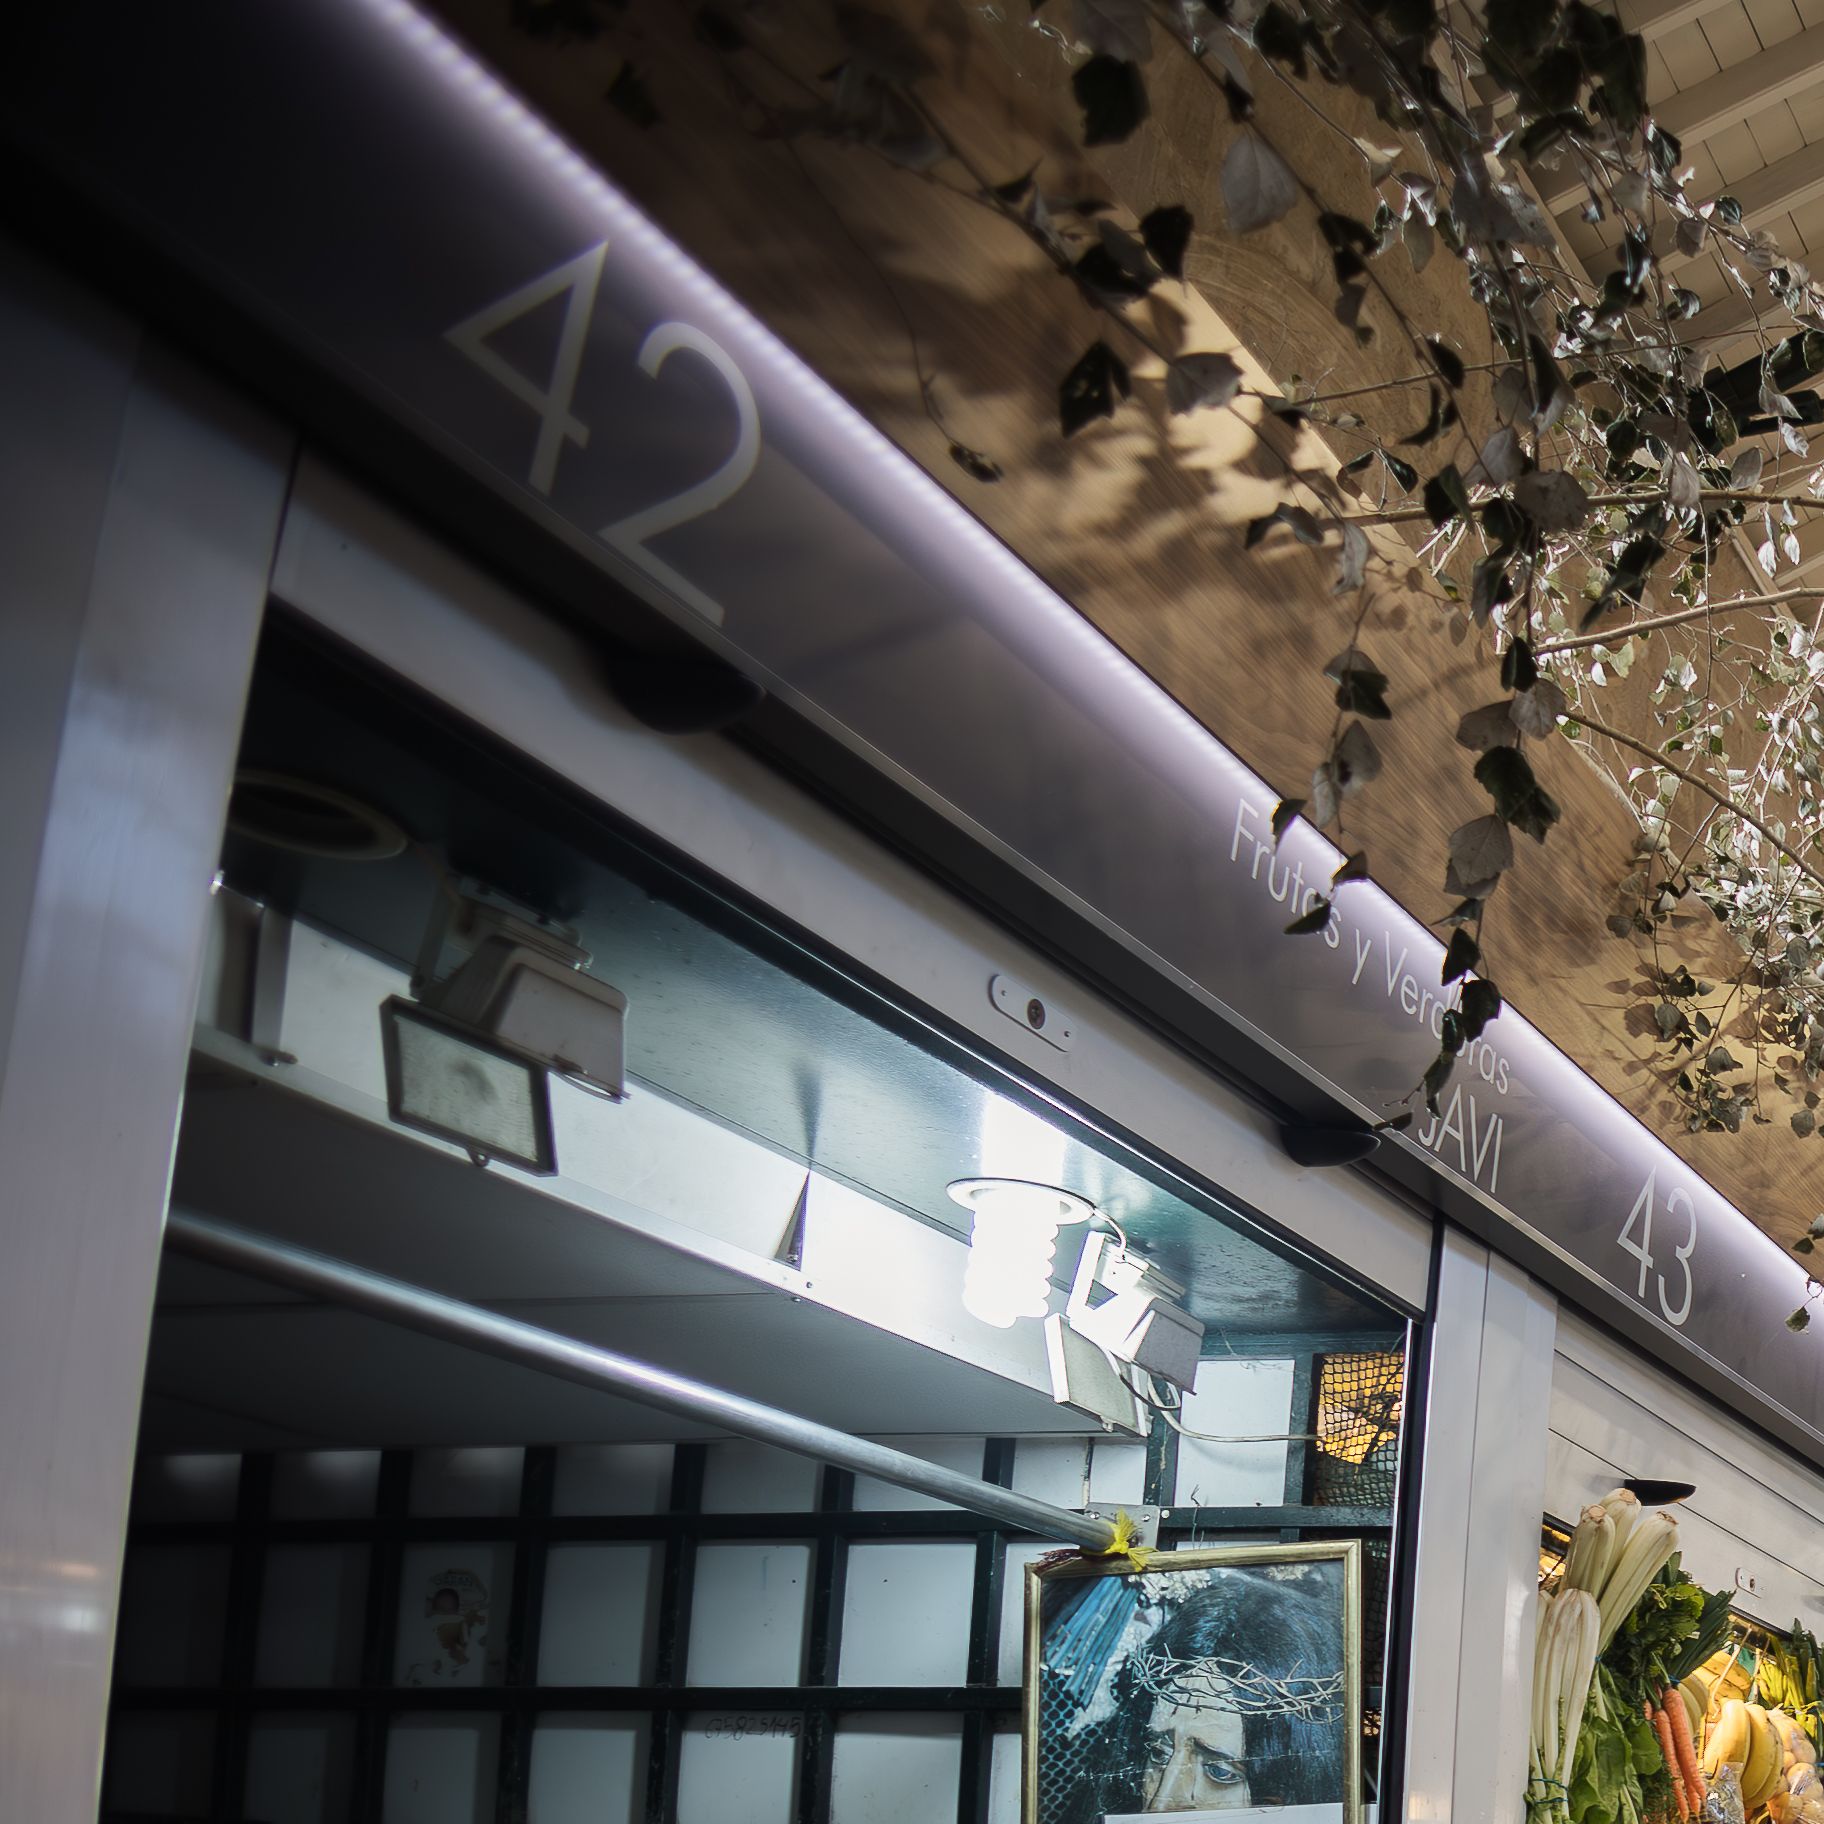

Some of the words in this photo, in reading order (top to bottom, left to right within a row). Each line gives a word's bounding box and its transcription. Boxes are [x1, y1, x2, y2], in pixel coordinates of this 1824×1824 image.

[443, 240, 764, 626] 42
[1352, 928, 1372, 986] y
[1385, 930, 1511, 1094] Verdras
[1616, 1166, 1698, 1327] 43
